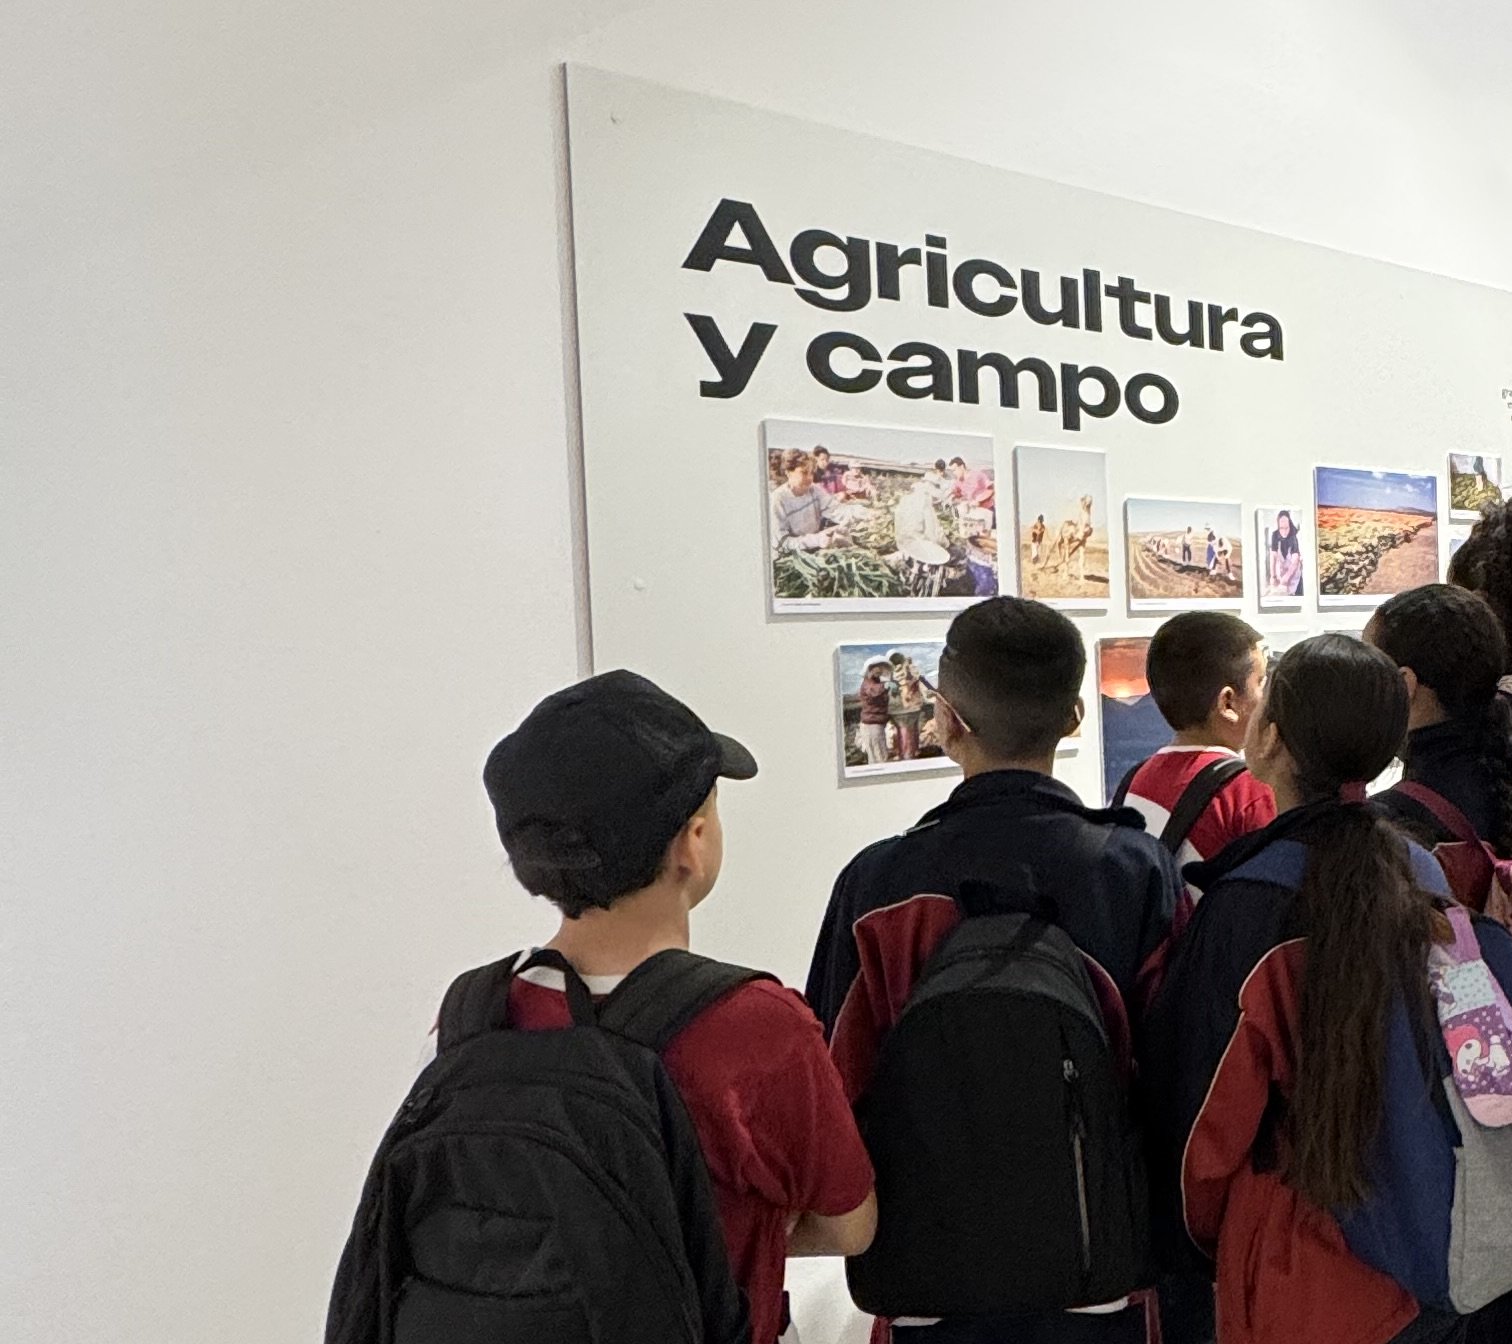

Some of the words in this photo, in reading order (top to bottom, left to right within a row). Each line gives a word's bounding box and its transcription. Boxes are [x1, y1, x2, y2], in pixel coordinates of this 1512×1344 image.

[681, 197, 1285, 362] Agricultura
[683, 312, 777, 399] y
[806, 329, 1180, 431] campo
